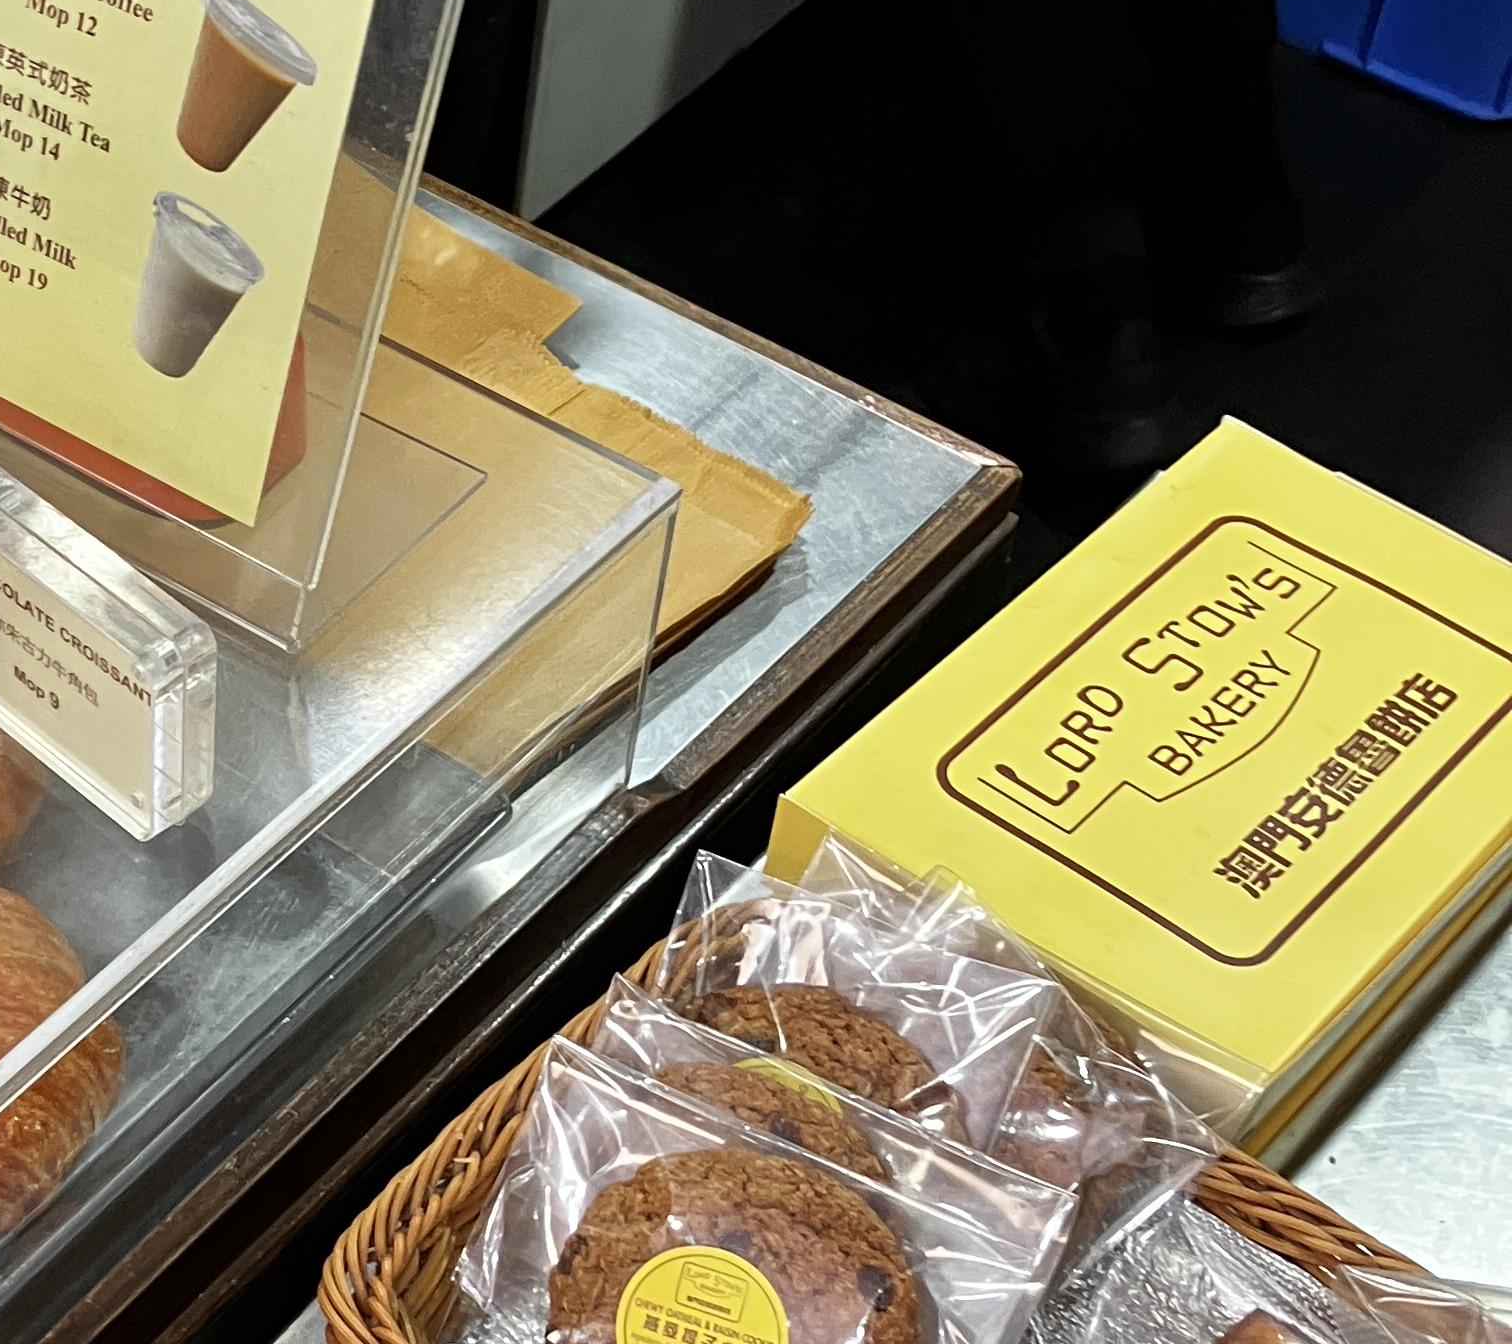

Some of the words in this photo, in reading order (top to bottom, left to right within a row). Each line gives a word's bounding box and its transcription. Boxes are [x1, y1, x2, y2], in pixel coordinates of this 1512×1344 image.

[77, 11, 99, 37] 12
[28, 99, 73, 136] Milk
[79, 120, 111, 153] Tea
[40, 136, 61, 161] 14
[32, 232, 77, 271] Milk
[28, 267, 49, 292] 19
[14, 665, 45, 699] Mop
[49, 692, 61, 710] 9
[59, 627, 153, 708] CROISSANT
[994, 685, 1125, 807] LORD
[1121, 567, 1301, 692] STOW'S
[1147, 649, 1292, 776] BAKERY
[1213, 672, 1459, 900] 澳門安德魯餅店
